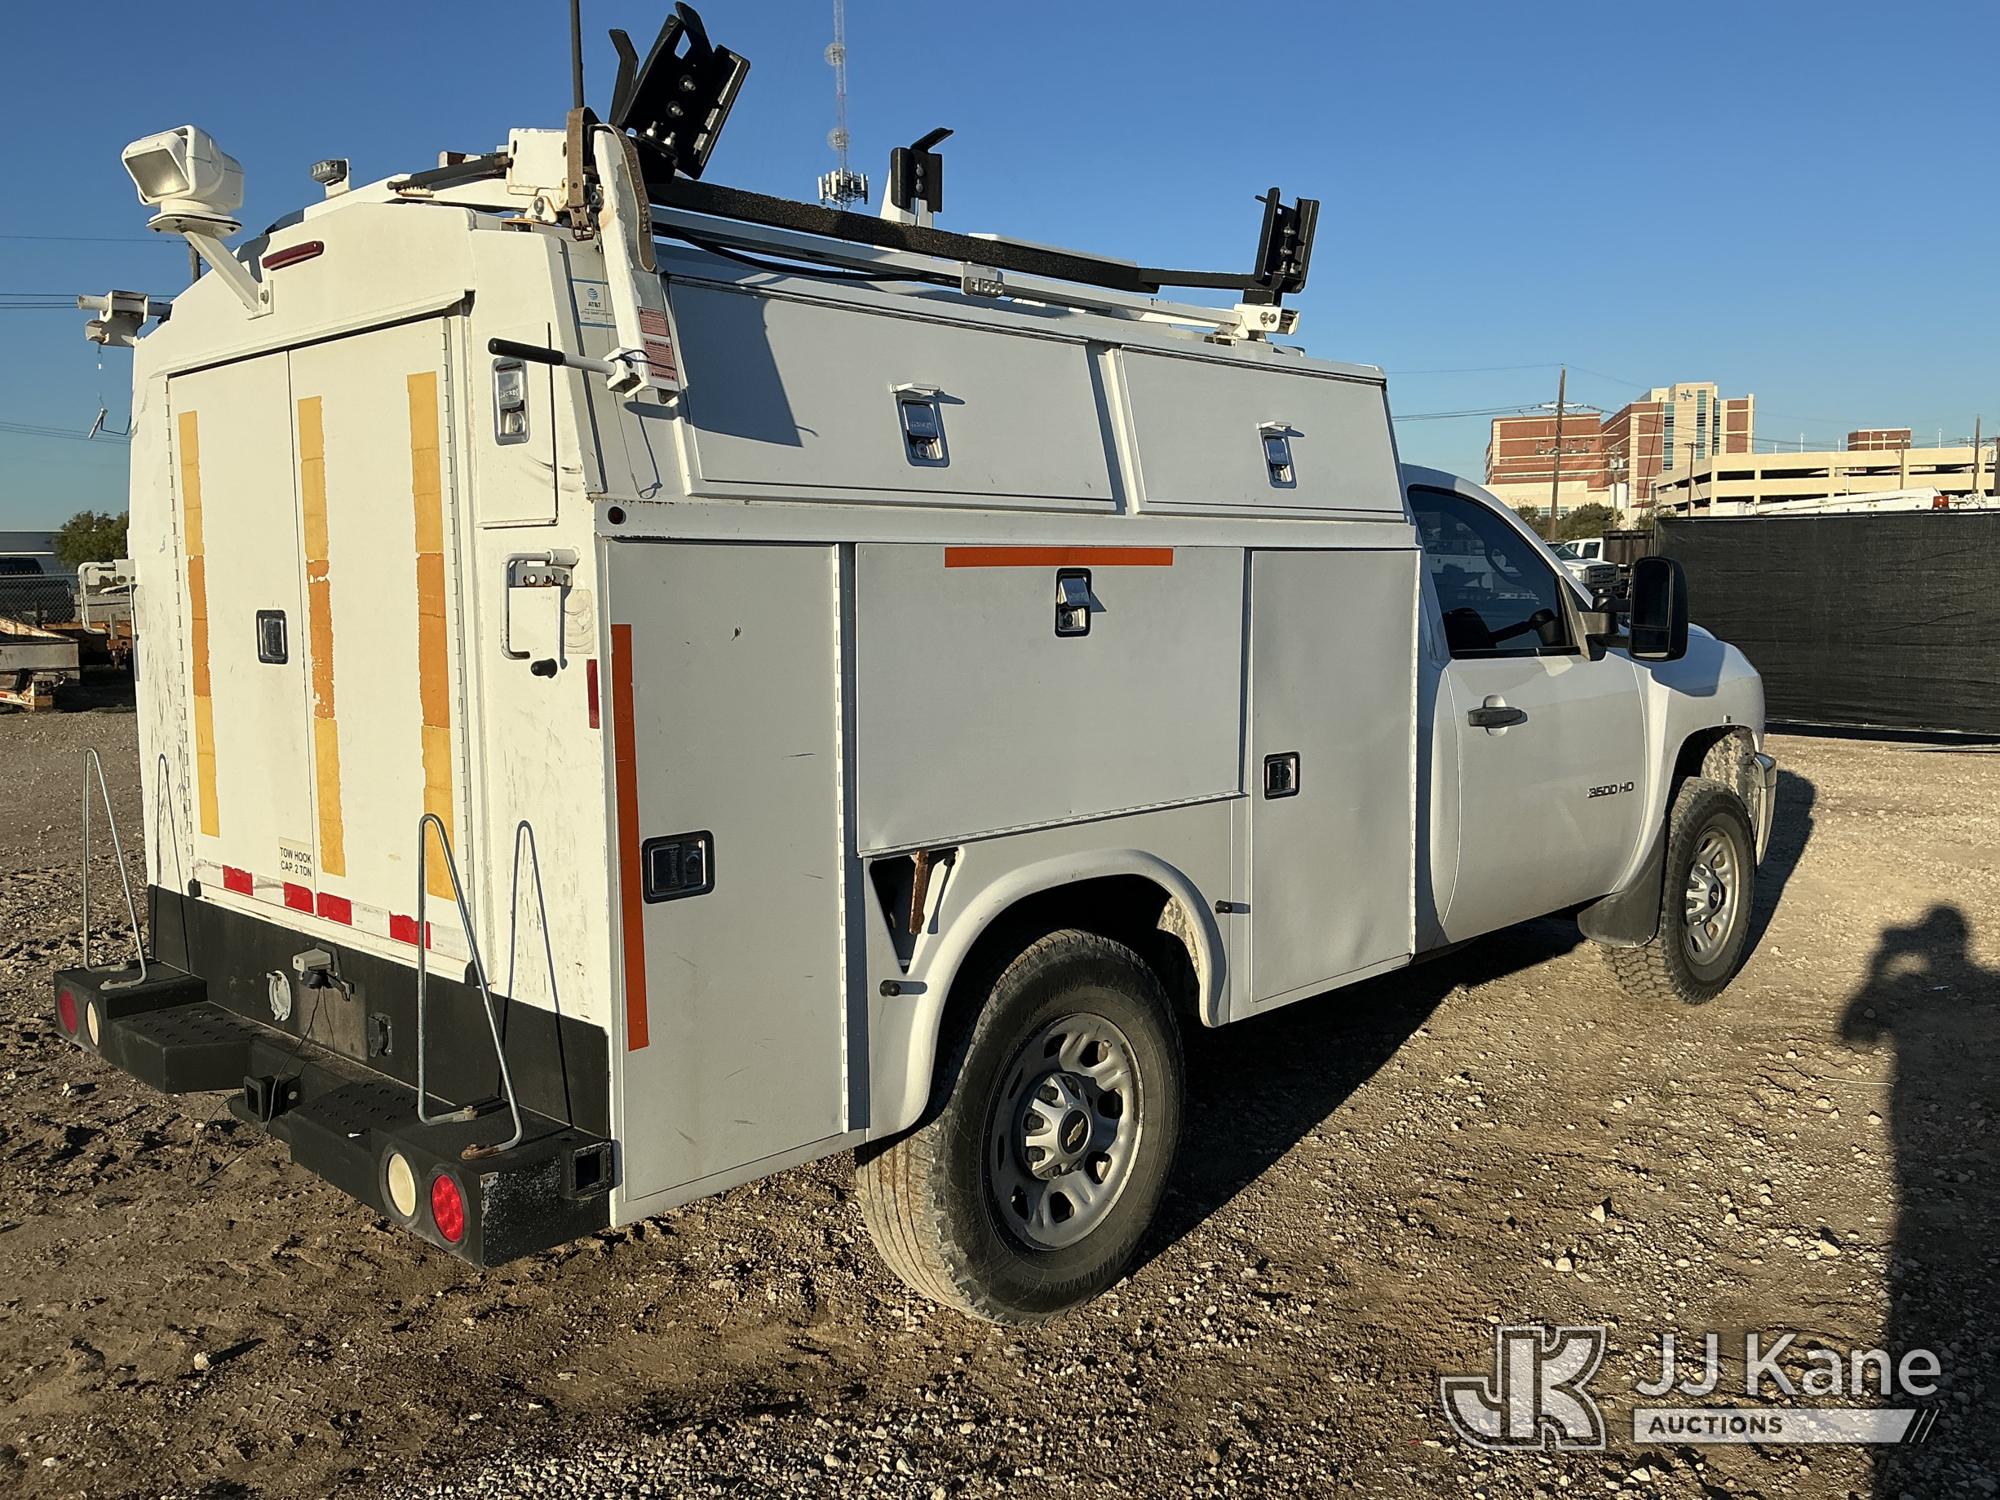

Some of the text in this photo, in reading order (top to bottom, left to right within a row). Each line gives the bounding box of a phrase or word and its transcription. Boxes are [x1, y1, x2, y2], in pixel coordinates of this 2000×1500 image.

[1587, 781, 1634, 798] 3500 HD
[280, 846, 312, 864] TOW HOOK
[299, 865, 312, 877] TON
